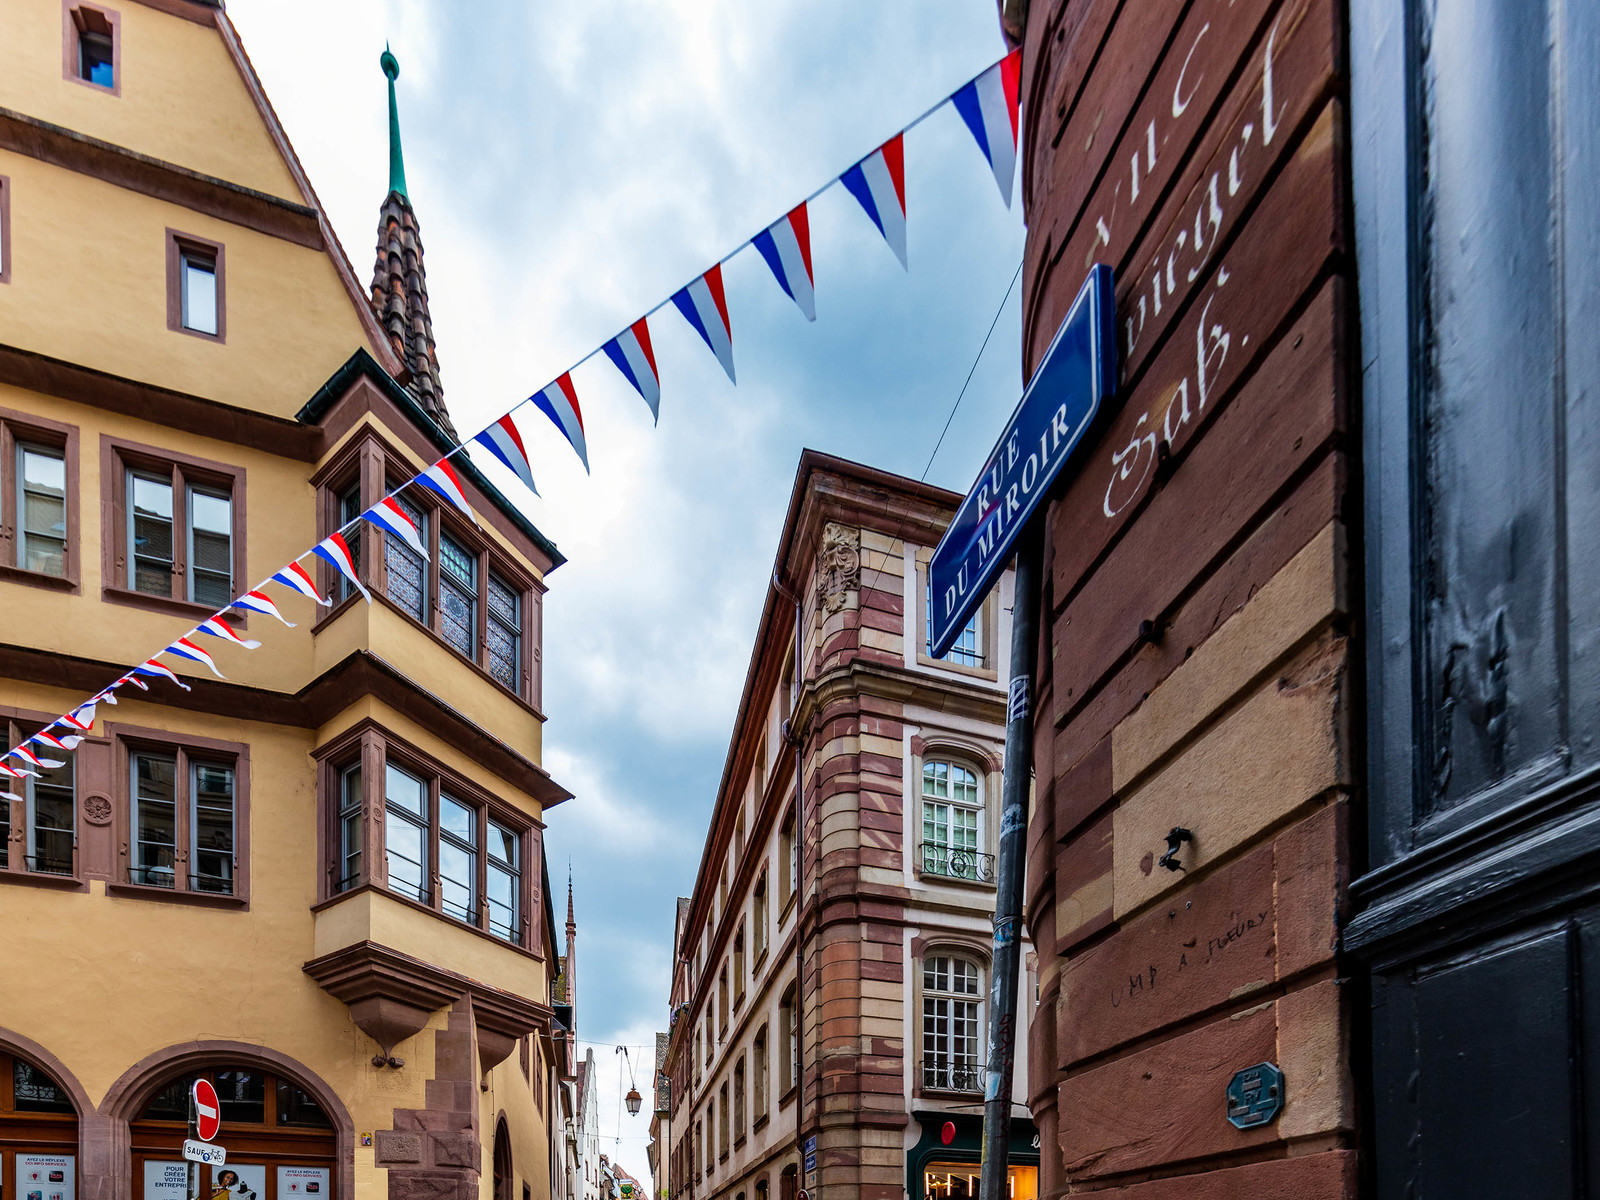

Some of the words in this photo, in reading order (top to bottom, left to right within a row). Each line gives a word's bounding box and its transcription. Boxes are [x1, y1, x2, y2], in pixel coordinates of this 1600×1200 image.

[944, 559, 970, 620] DU
[977, 402, 1070, 569] MIROIR
[976, 427, 1020, 525] RUE
[186, 1146, 206, 1156] SAUF
